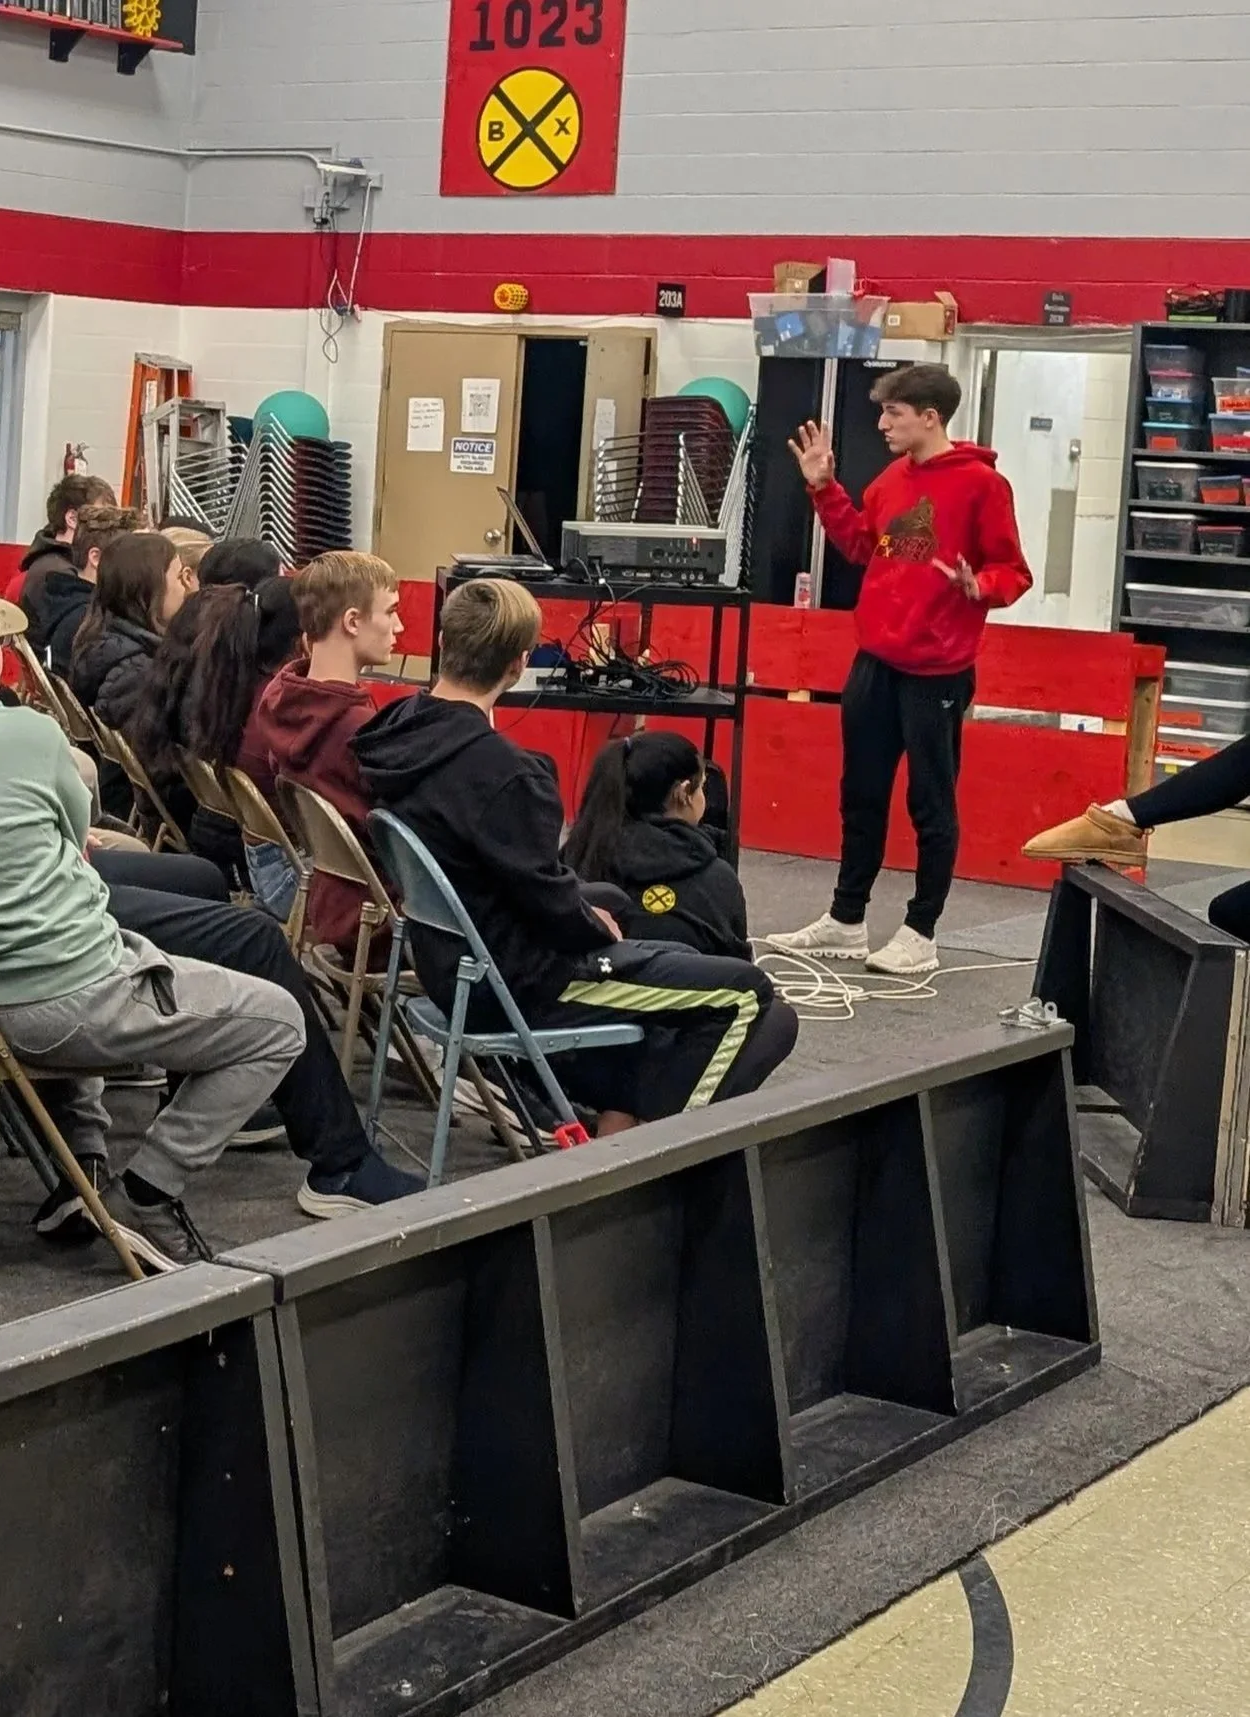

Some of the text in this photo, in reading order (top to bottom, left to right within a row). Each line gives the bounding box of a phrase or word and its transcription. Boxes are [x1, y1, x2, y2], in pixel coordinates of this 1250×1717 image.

[469, 0, 604, 51] 1023
[488, 117, 572, 141] B X
[658, 290, 683, 308] 203A
[454, 442, 492, 453] NOTICE
